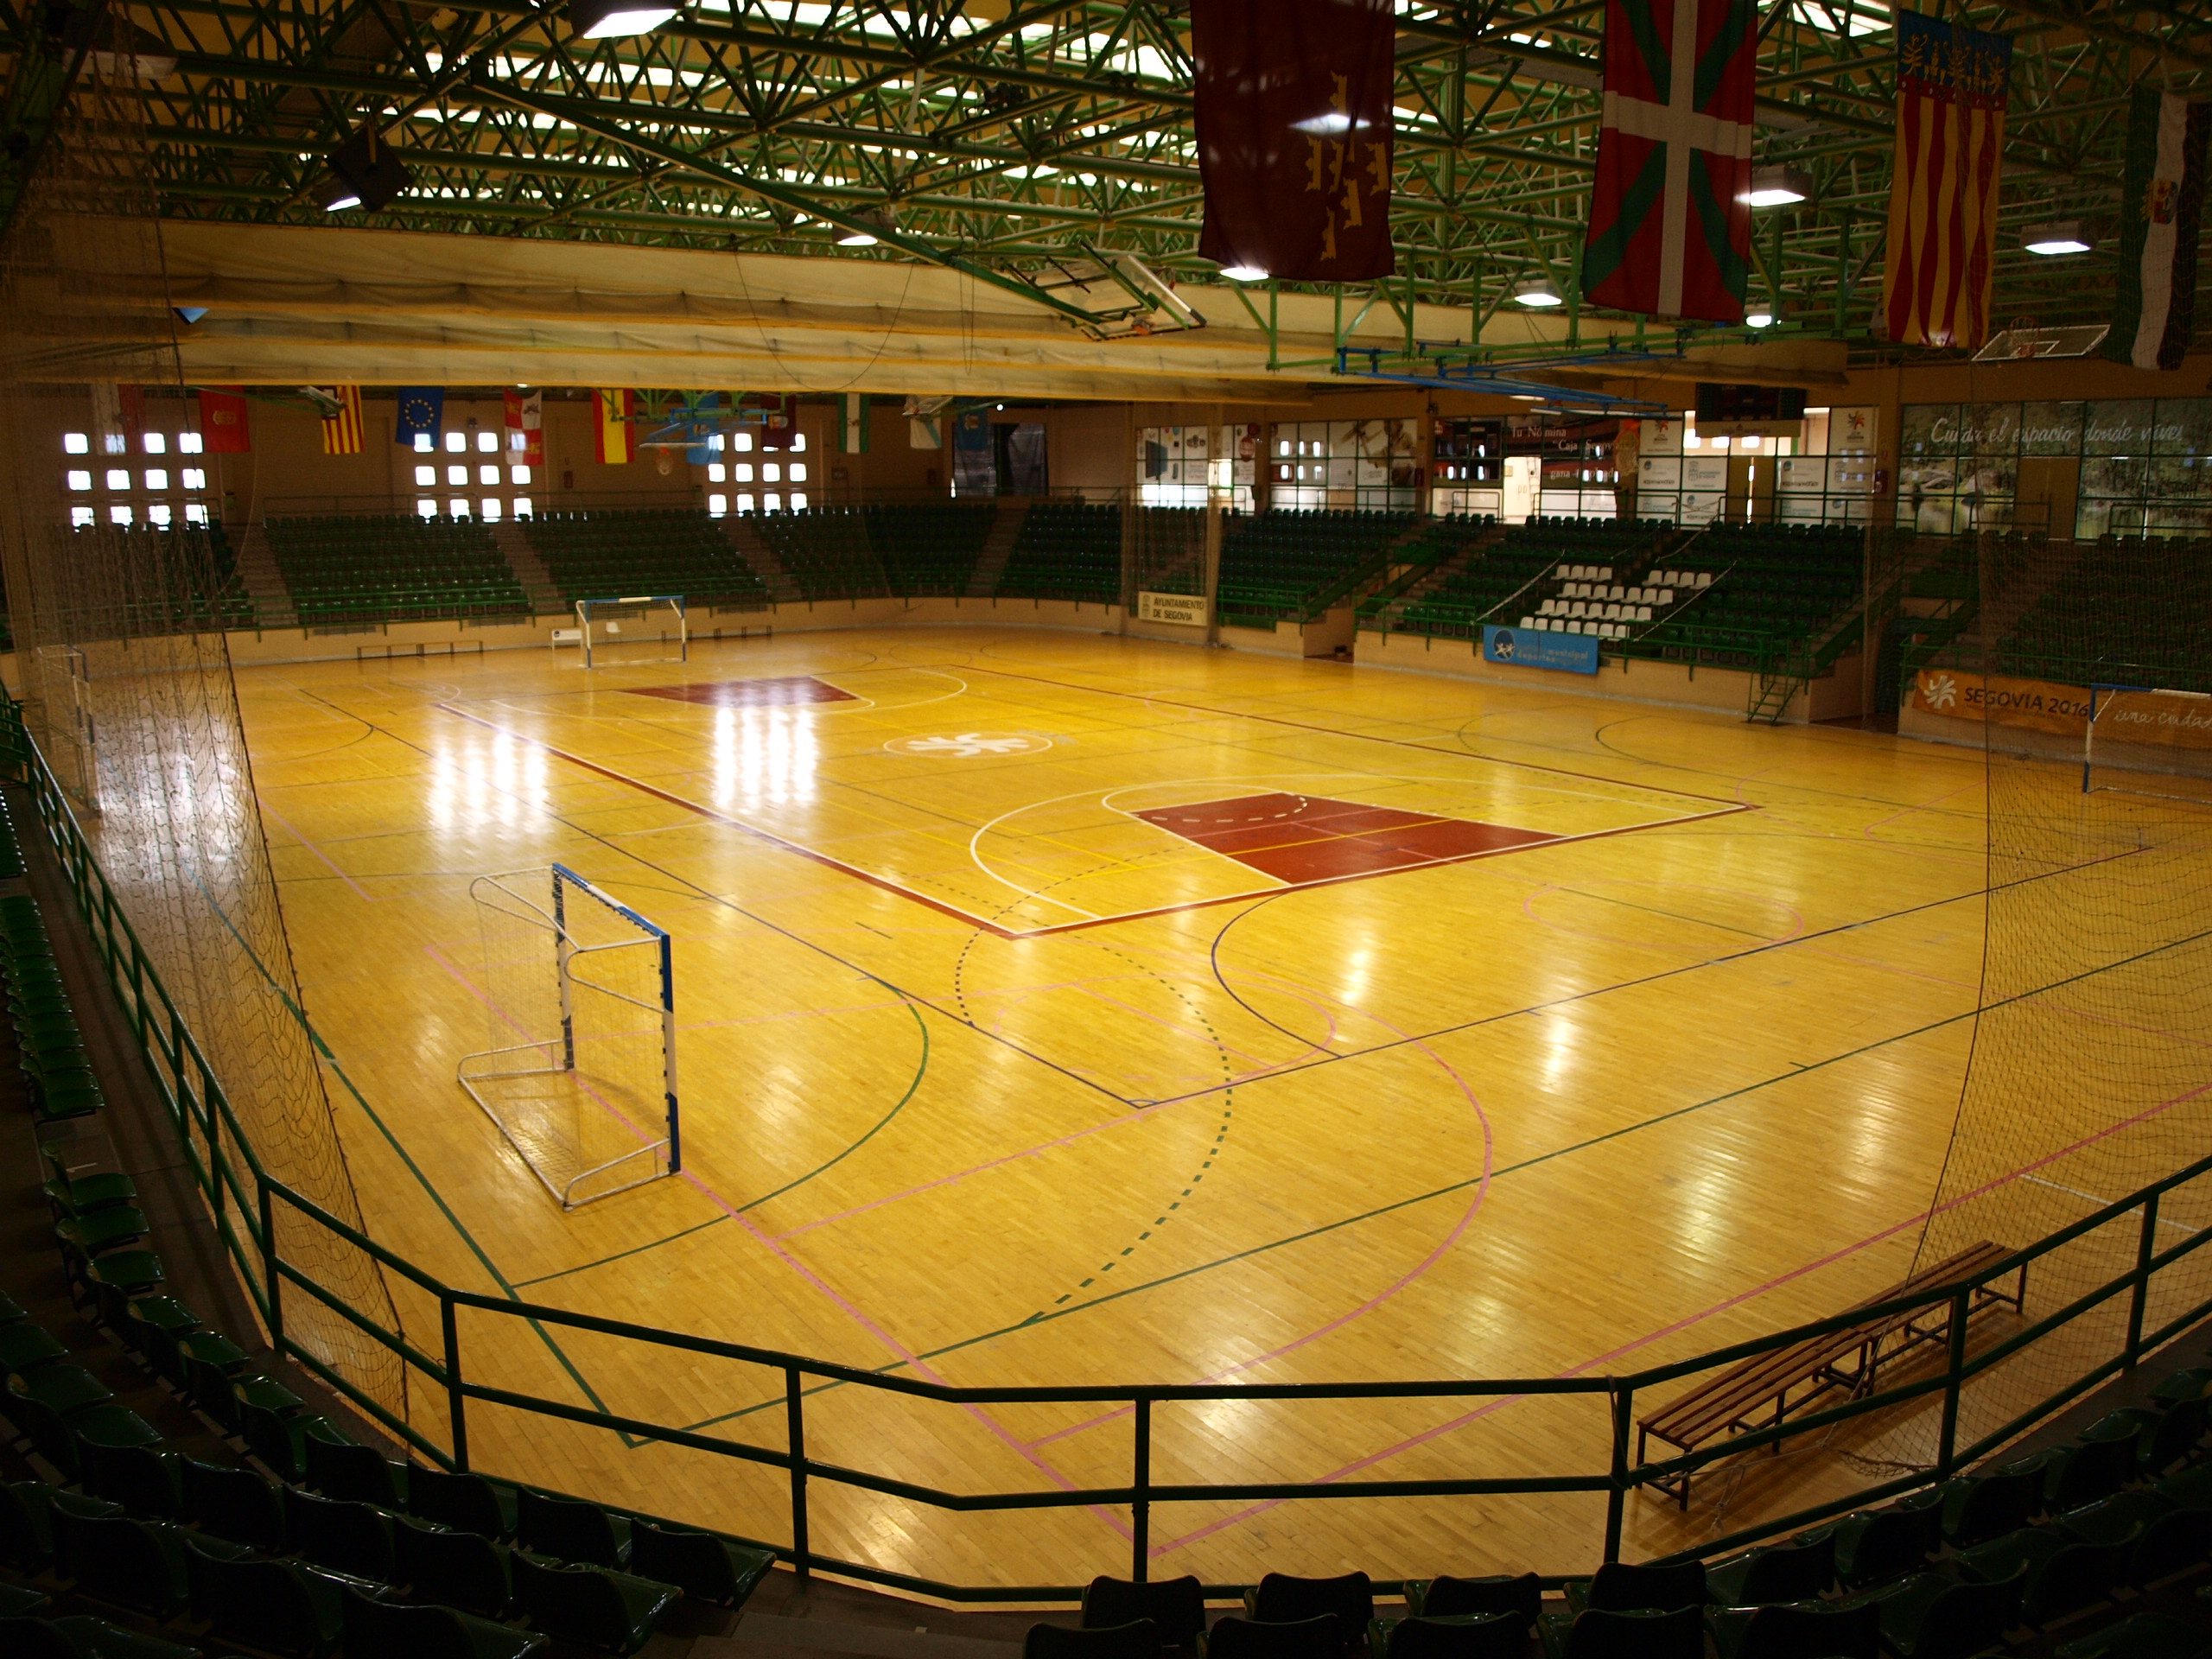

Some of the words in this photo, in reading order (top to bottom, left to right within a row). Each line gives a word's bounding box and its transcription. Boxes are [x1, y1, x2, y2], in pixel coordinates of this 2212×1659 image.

[1931, 417, 1980, 442] Cuida
[1988, 417, 2010, 442] el
[2012, 425, 2075, 448] espacio
[2083, 419, 2133, 442] donde
[1558, 439, 1578, 452] Caja
[1154, 597, 1205, 609] AYUNTAMIENTO
[1154, 608, 1161, 618] DE
[1164, 610, 1192, 621] SEGOVIA
[1964, 688, 2044, 710] SEGOVIA
[2048, 698, 2090, 716] 2016
